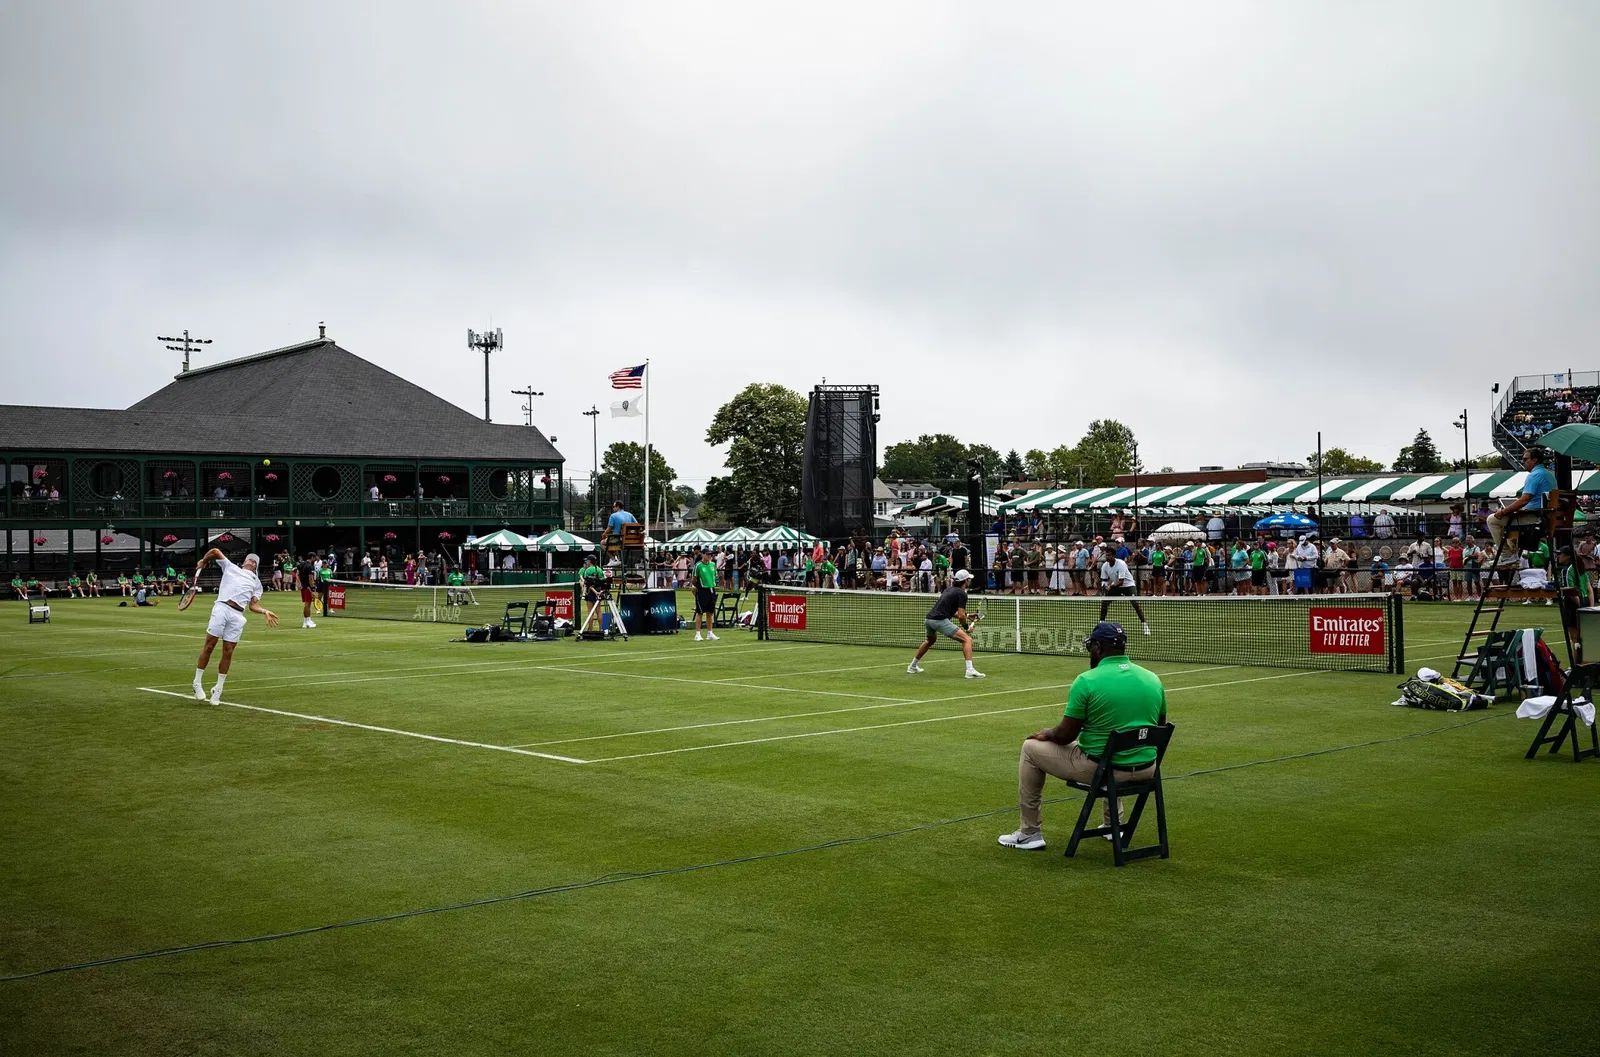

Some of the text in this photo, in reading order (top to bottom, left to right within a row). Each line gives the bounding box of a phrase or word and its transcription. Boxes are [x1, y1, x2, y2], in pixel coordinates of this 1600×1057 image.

[436, 605, 461, 621] TOUR
[650, 605, 676, 615] DASANI
[770, 601, 804, 614] Emirates
[783, 614, 799, 624] BETTER
[1313, 616, 1380, 632] Emirates
[1020, 627, 1088, 653] TOUR
[1323, 633, 1370, 647] FLY BETTER
